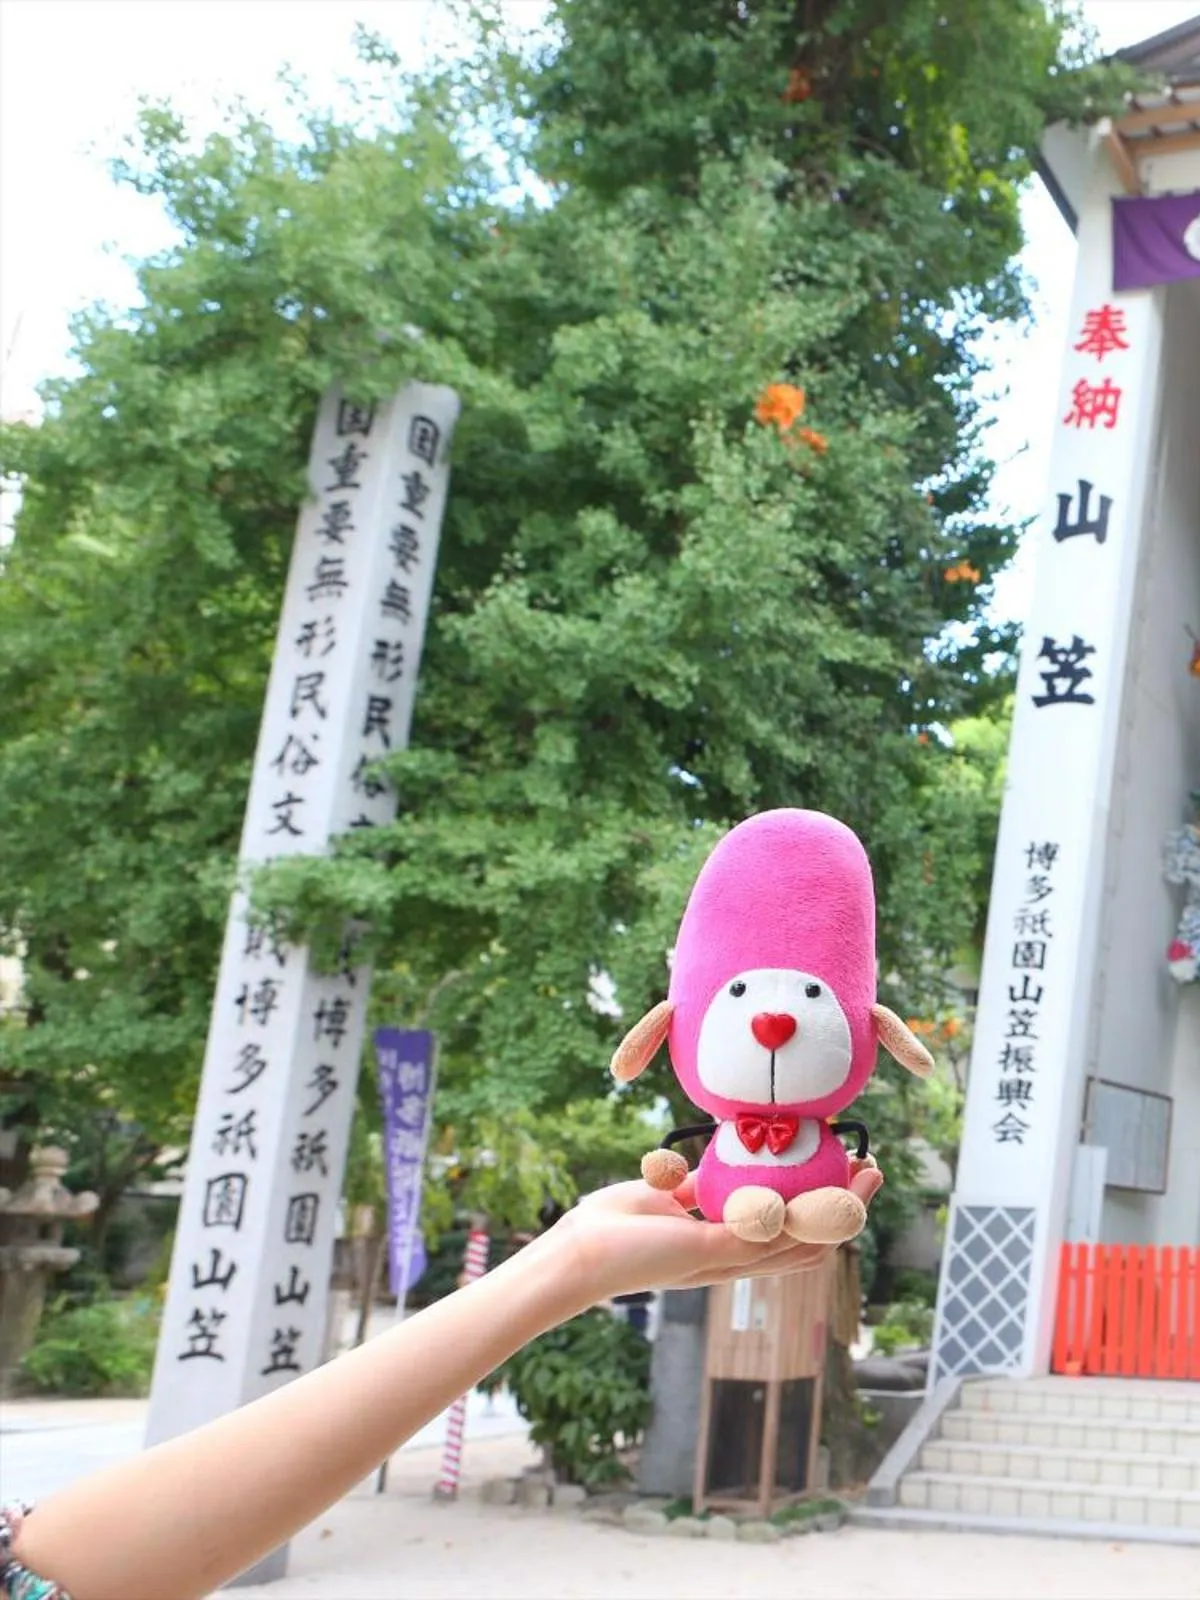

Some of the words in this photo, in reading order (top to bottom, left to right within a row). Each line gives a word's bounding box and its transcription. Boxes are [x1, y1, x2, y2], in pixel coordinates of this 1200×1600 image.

[1063, 304, 1130, 430] 奉納
[1030, 479, 1114, 710] 山笠
[177, 397, 376, 1363] 国重要無形民俗文博多祇園山笠
[991, 841, 1061, 1146] 博多祇園山笠振興会
